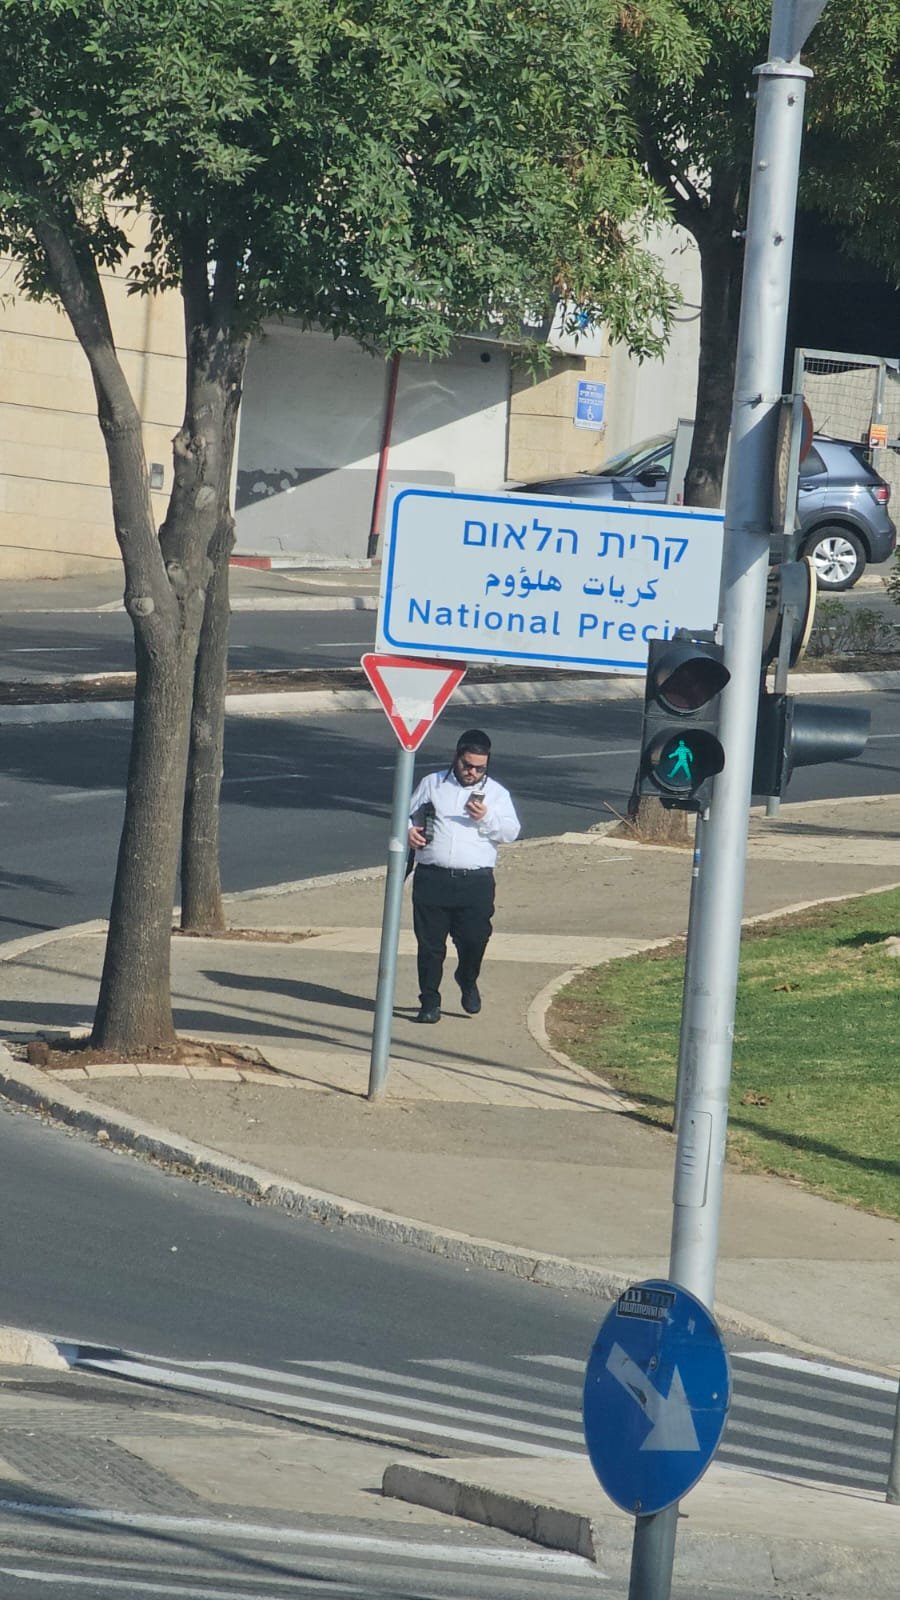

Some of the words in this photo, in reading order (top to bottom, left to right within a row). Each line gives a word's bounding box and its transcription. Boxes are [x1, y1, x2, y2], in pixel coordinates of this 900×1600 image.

[462, 518, 580, 556] הלאום
[596, 531, 690, 572] קרית
[485, 567, 562, 600] هلؤوم
[582, 575, 658, 608] كريات
[407, 598, 561, 637] National
